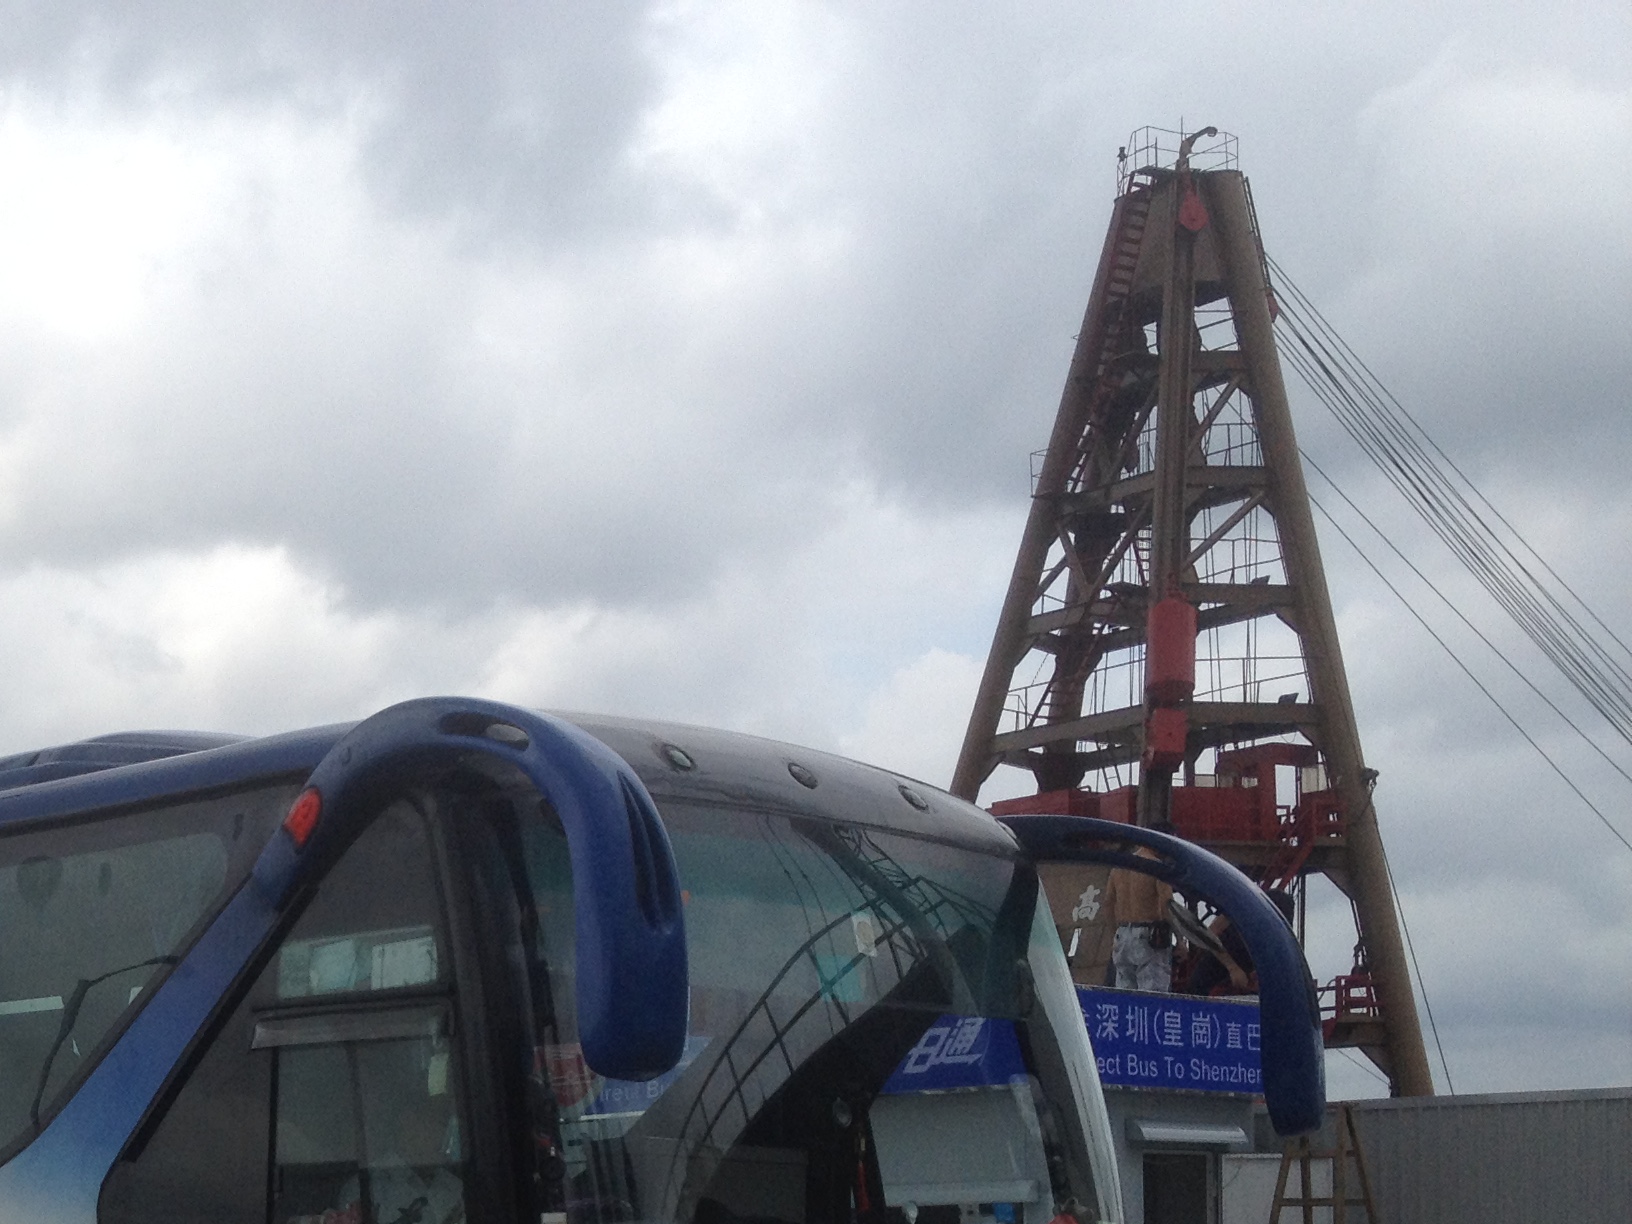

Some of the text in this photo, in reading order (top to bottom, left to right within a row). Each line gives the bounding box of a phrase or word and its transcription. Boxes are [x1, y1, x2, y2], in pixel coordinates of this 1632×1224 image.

[1097, 1054, 1122, 1076] ect
[1127, 1054, 1159, 1078] Bus
[1164, 1056, 1185, 1080] To
